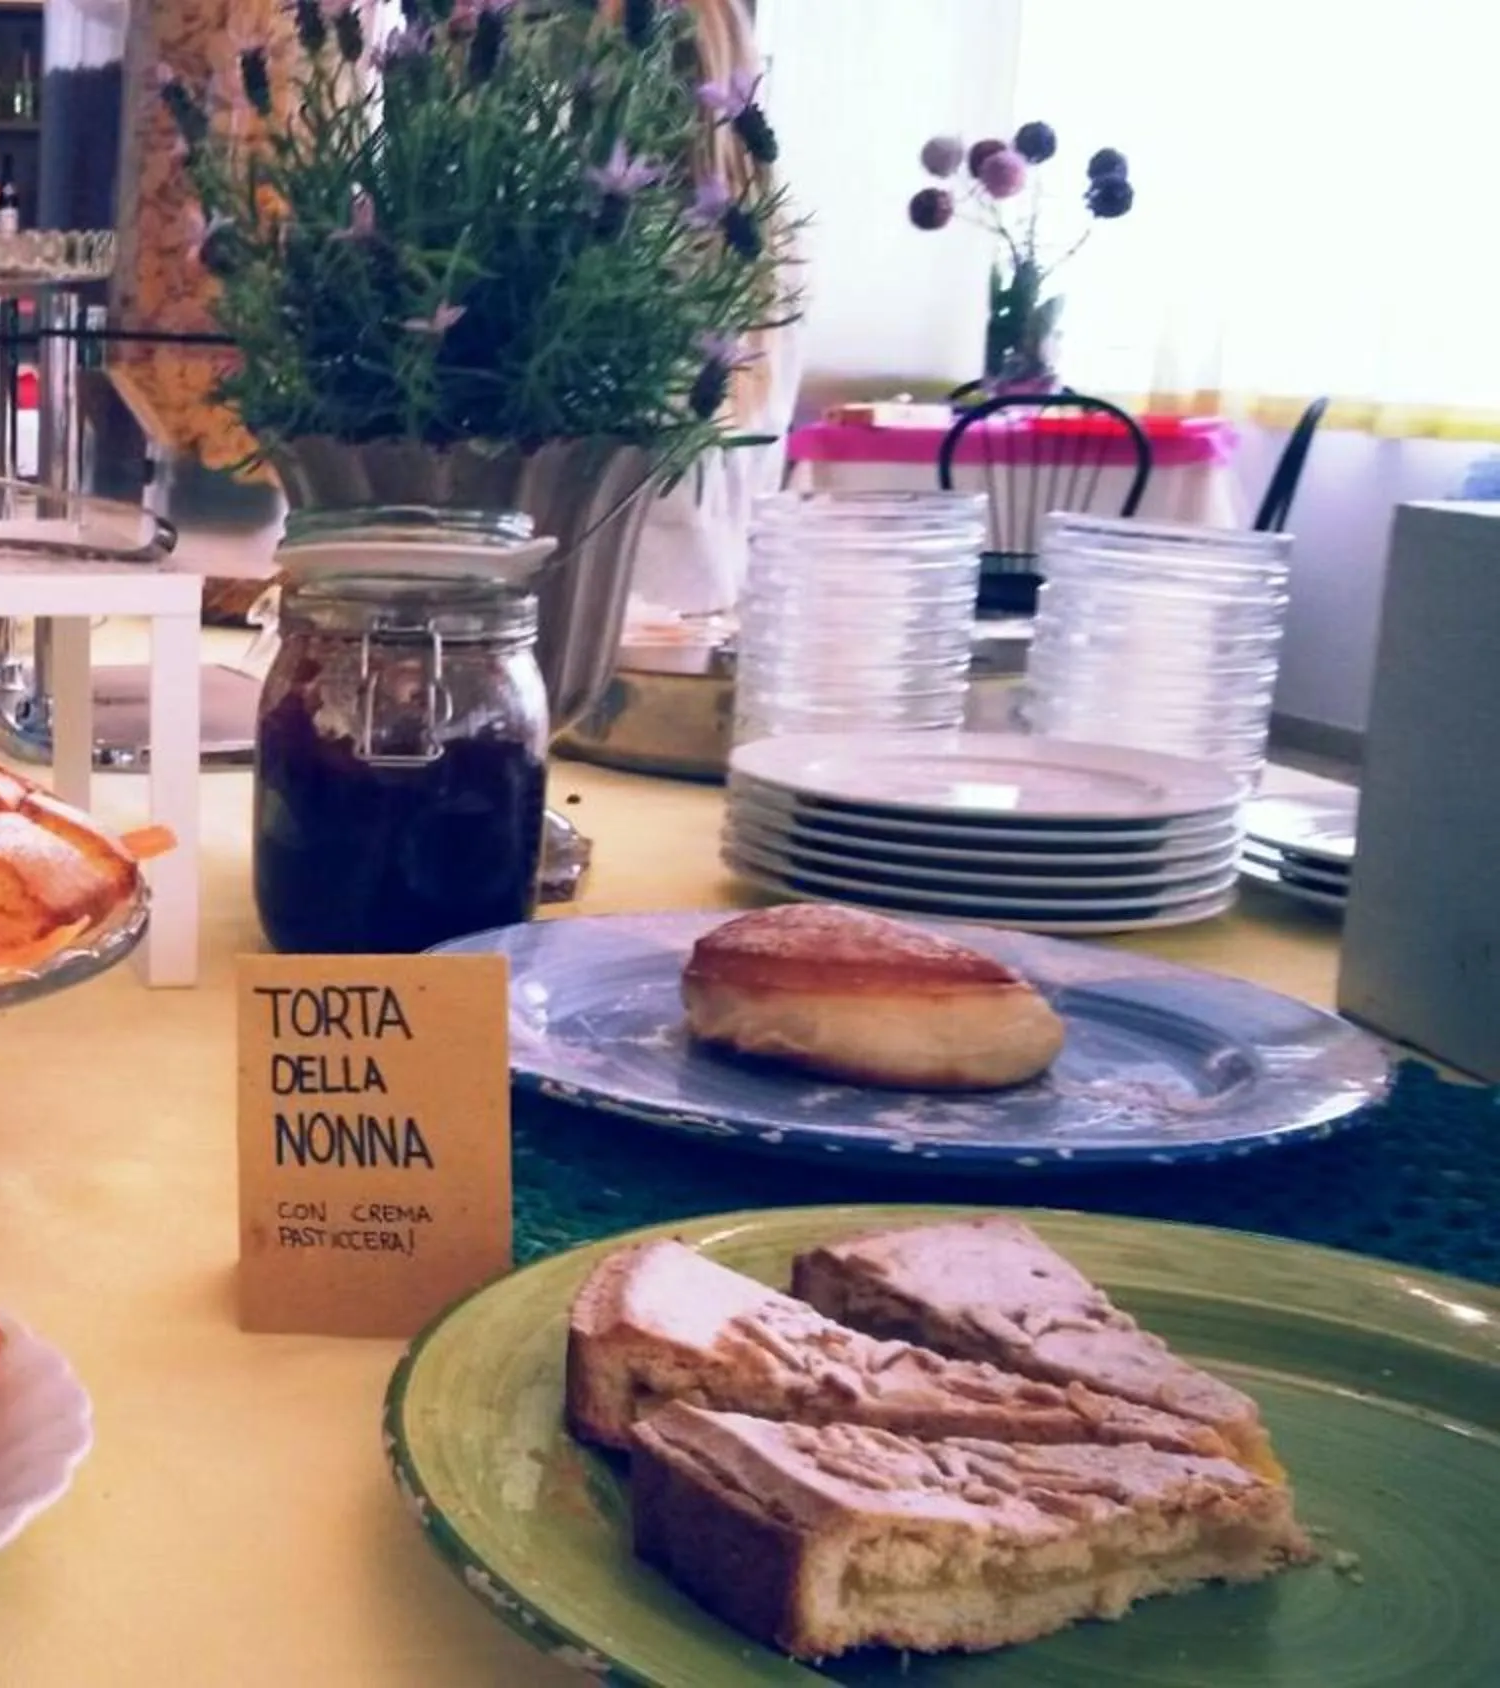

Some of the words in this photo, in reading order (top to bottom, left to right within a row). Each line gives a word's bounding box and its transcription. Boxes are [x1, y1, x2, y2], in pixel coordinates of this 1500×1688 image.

[253, 985, 414, 1040] TORTA
[271, 1053, 387, 1095] DELLA
[274, 1111, 434, 1170] NONNA
[277, 1202, 327, 1223] CON
[351, 1204, 433, 1224] CREMA
[277, 1226, 415, 1254] PASTICCERA!
